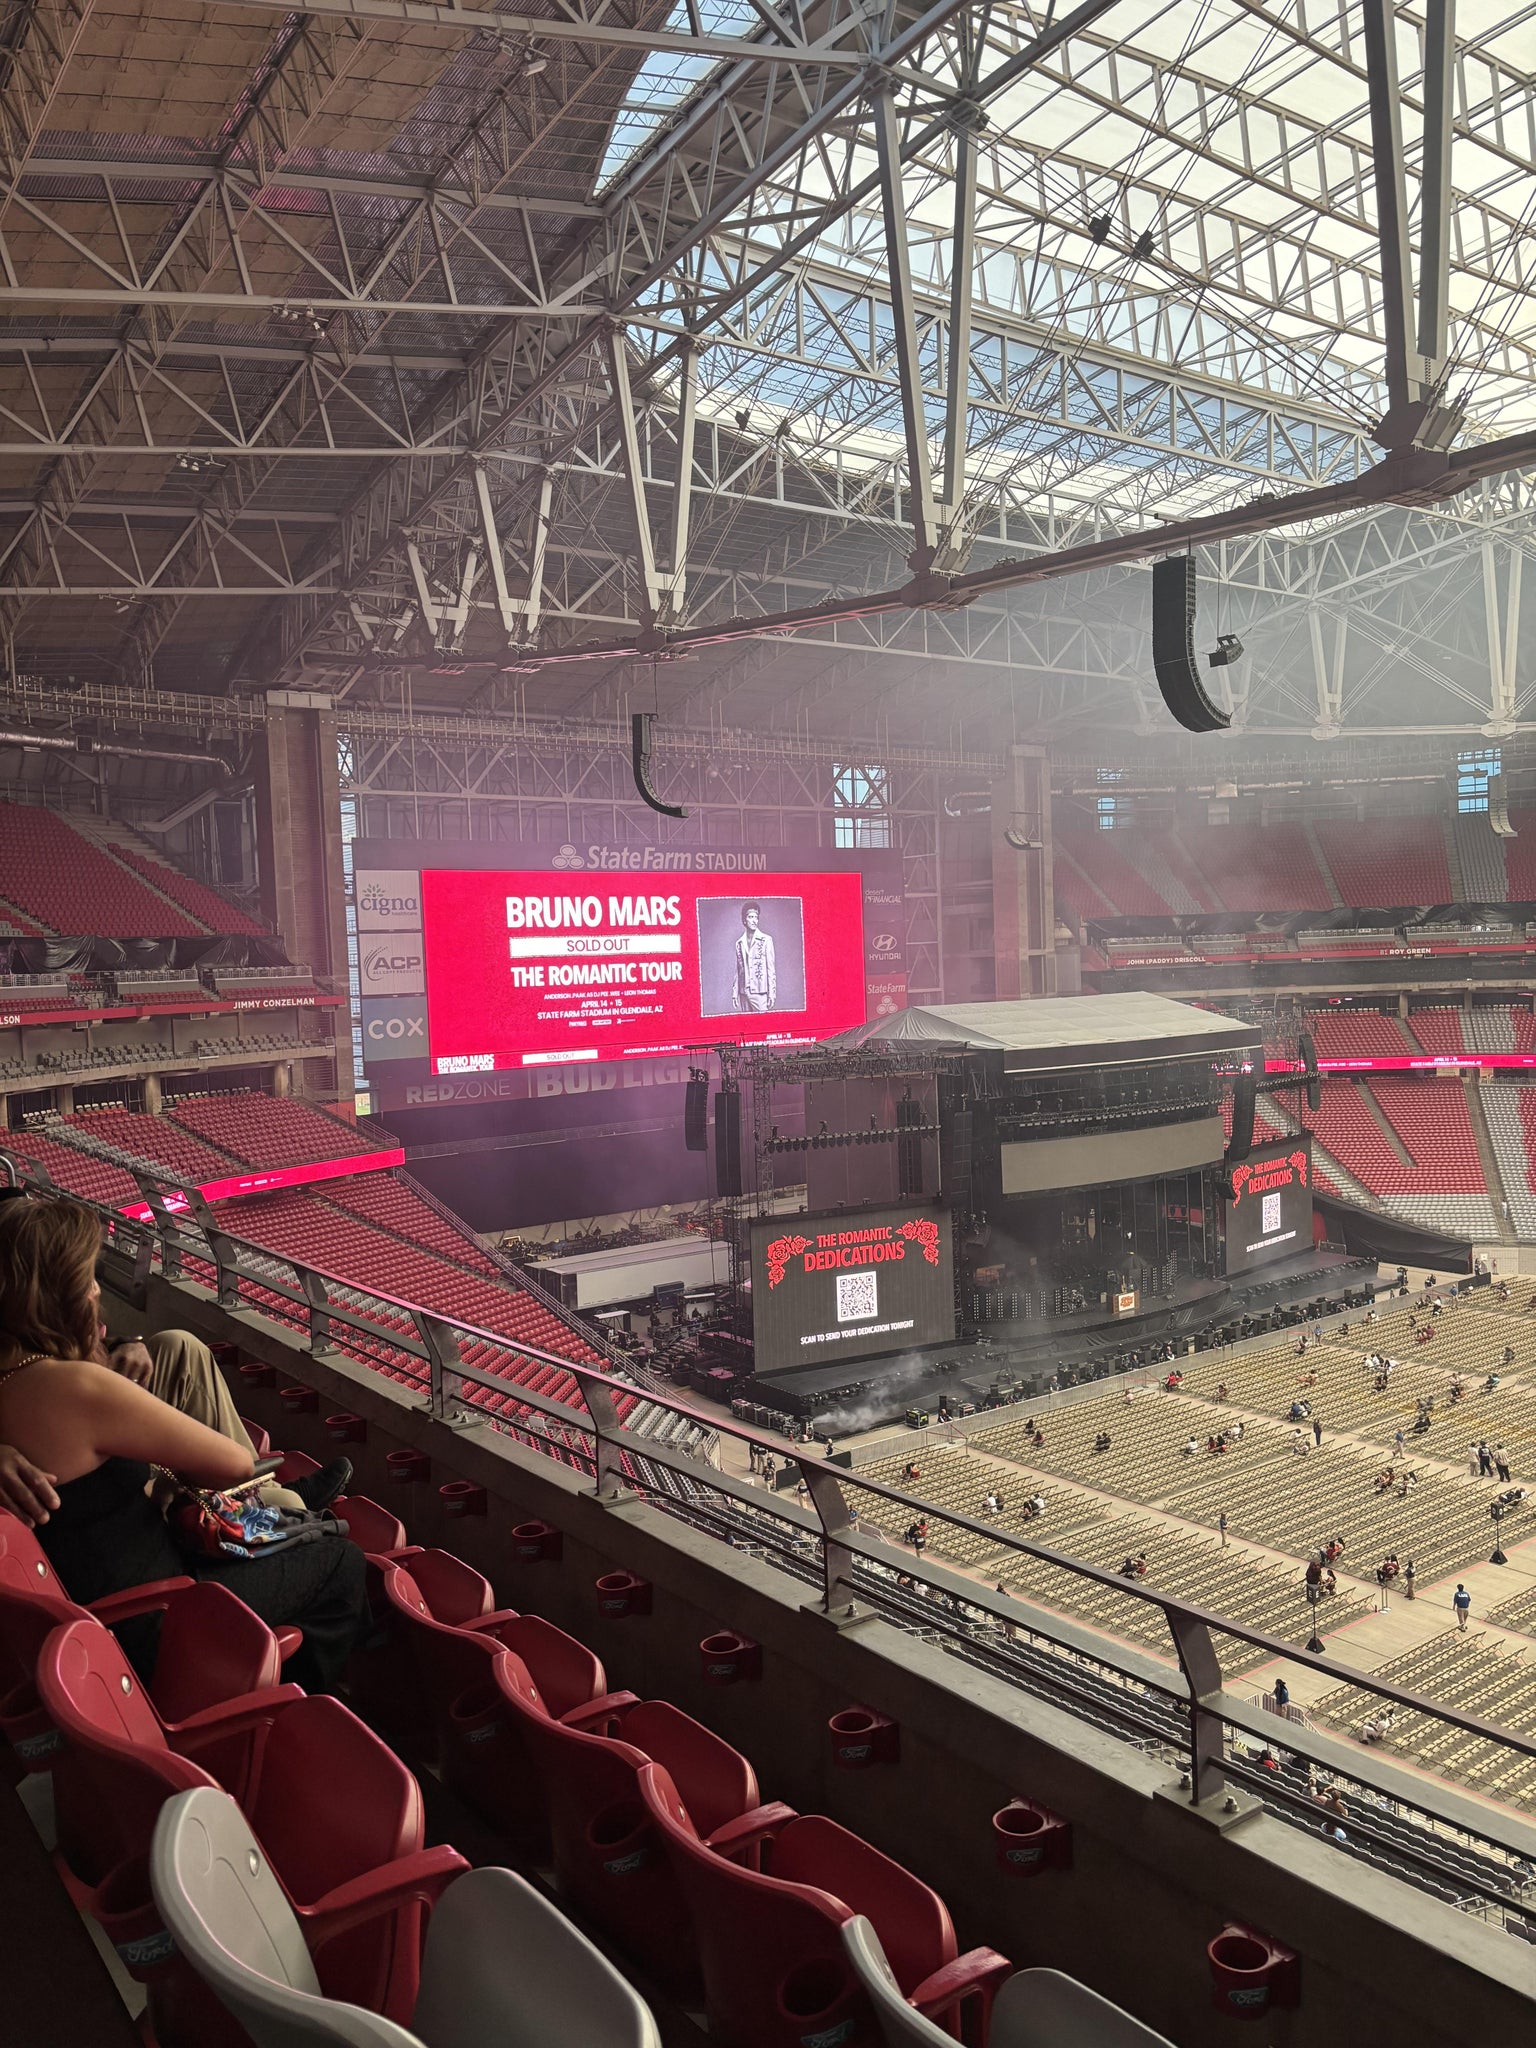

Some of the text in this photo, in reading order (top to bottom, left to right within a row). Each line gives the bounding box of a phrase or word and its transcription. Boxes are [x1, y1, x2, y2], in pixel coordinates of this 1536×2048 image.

[695, 853, 767, 871] STADIUM
[360, 895, 417, 916] cigna
[505, 896, 682, 928] BRUNO MARS
[566, 938, 630, 952] SOLD OUT
[373, 956, 421, 970] ACP
[869, 952, 901, 960] HYUNDAI
[511, 961, 683, 987] THE ROMANTIC TOUR
[233, 997, 315, 1010] JIMMY CONZELMAN
[537, 1010, 559, 1020] STATE
[560, 1009, 580, 1018] FARM
[580, 1008, 612, 1018] STADIUM
[581, 1000, 599, 1008] APRIL
[368, 1017, 424, 1040] COX
[437, 1054, 495, 1067] BRUNO MARS
[406, 1078, 511, 1104] REDZONE
[537, 1064, 617, 1098] BUD
[1248, 1168, 1293, 1194] DEDICATIONS
[817, 1227, 893, 1248] THE ROMANTIC
[804, 1241, 905, 1272] DEDICATIONS
[800, 1319, 914, 1345] SCAN TO SEND YOUR DEDICATION TONIGHT
